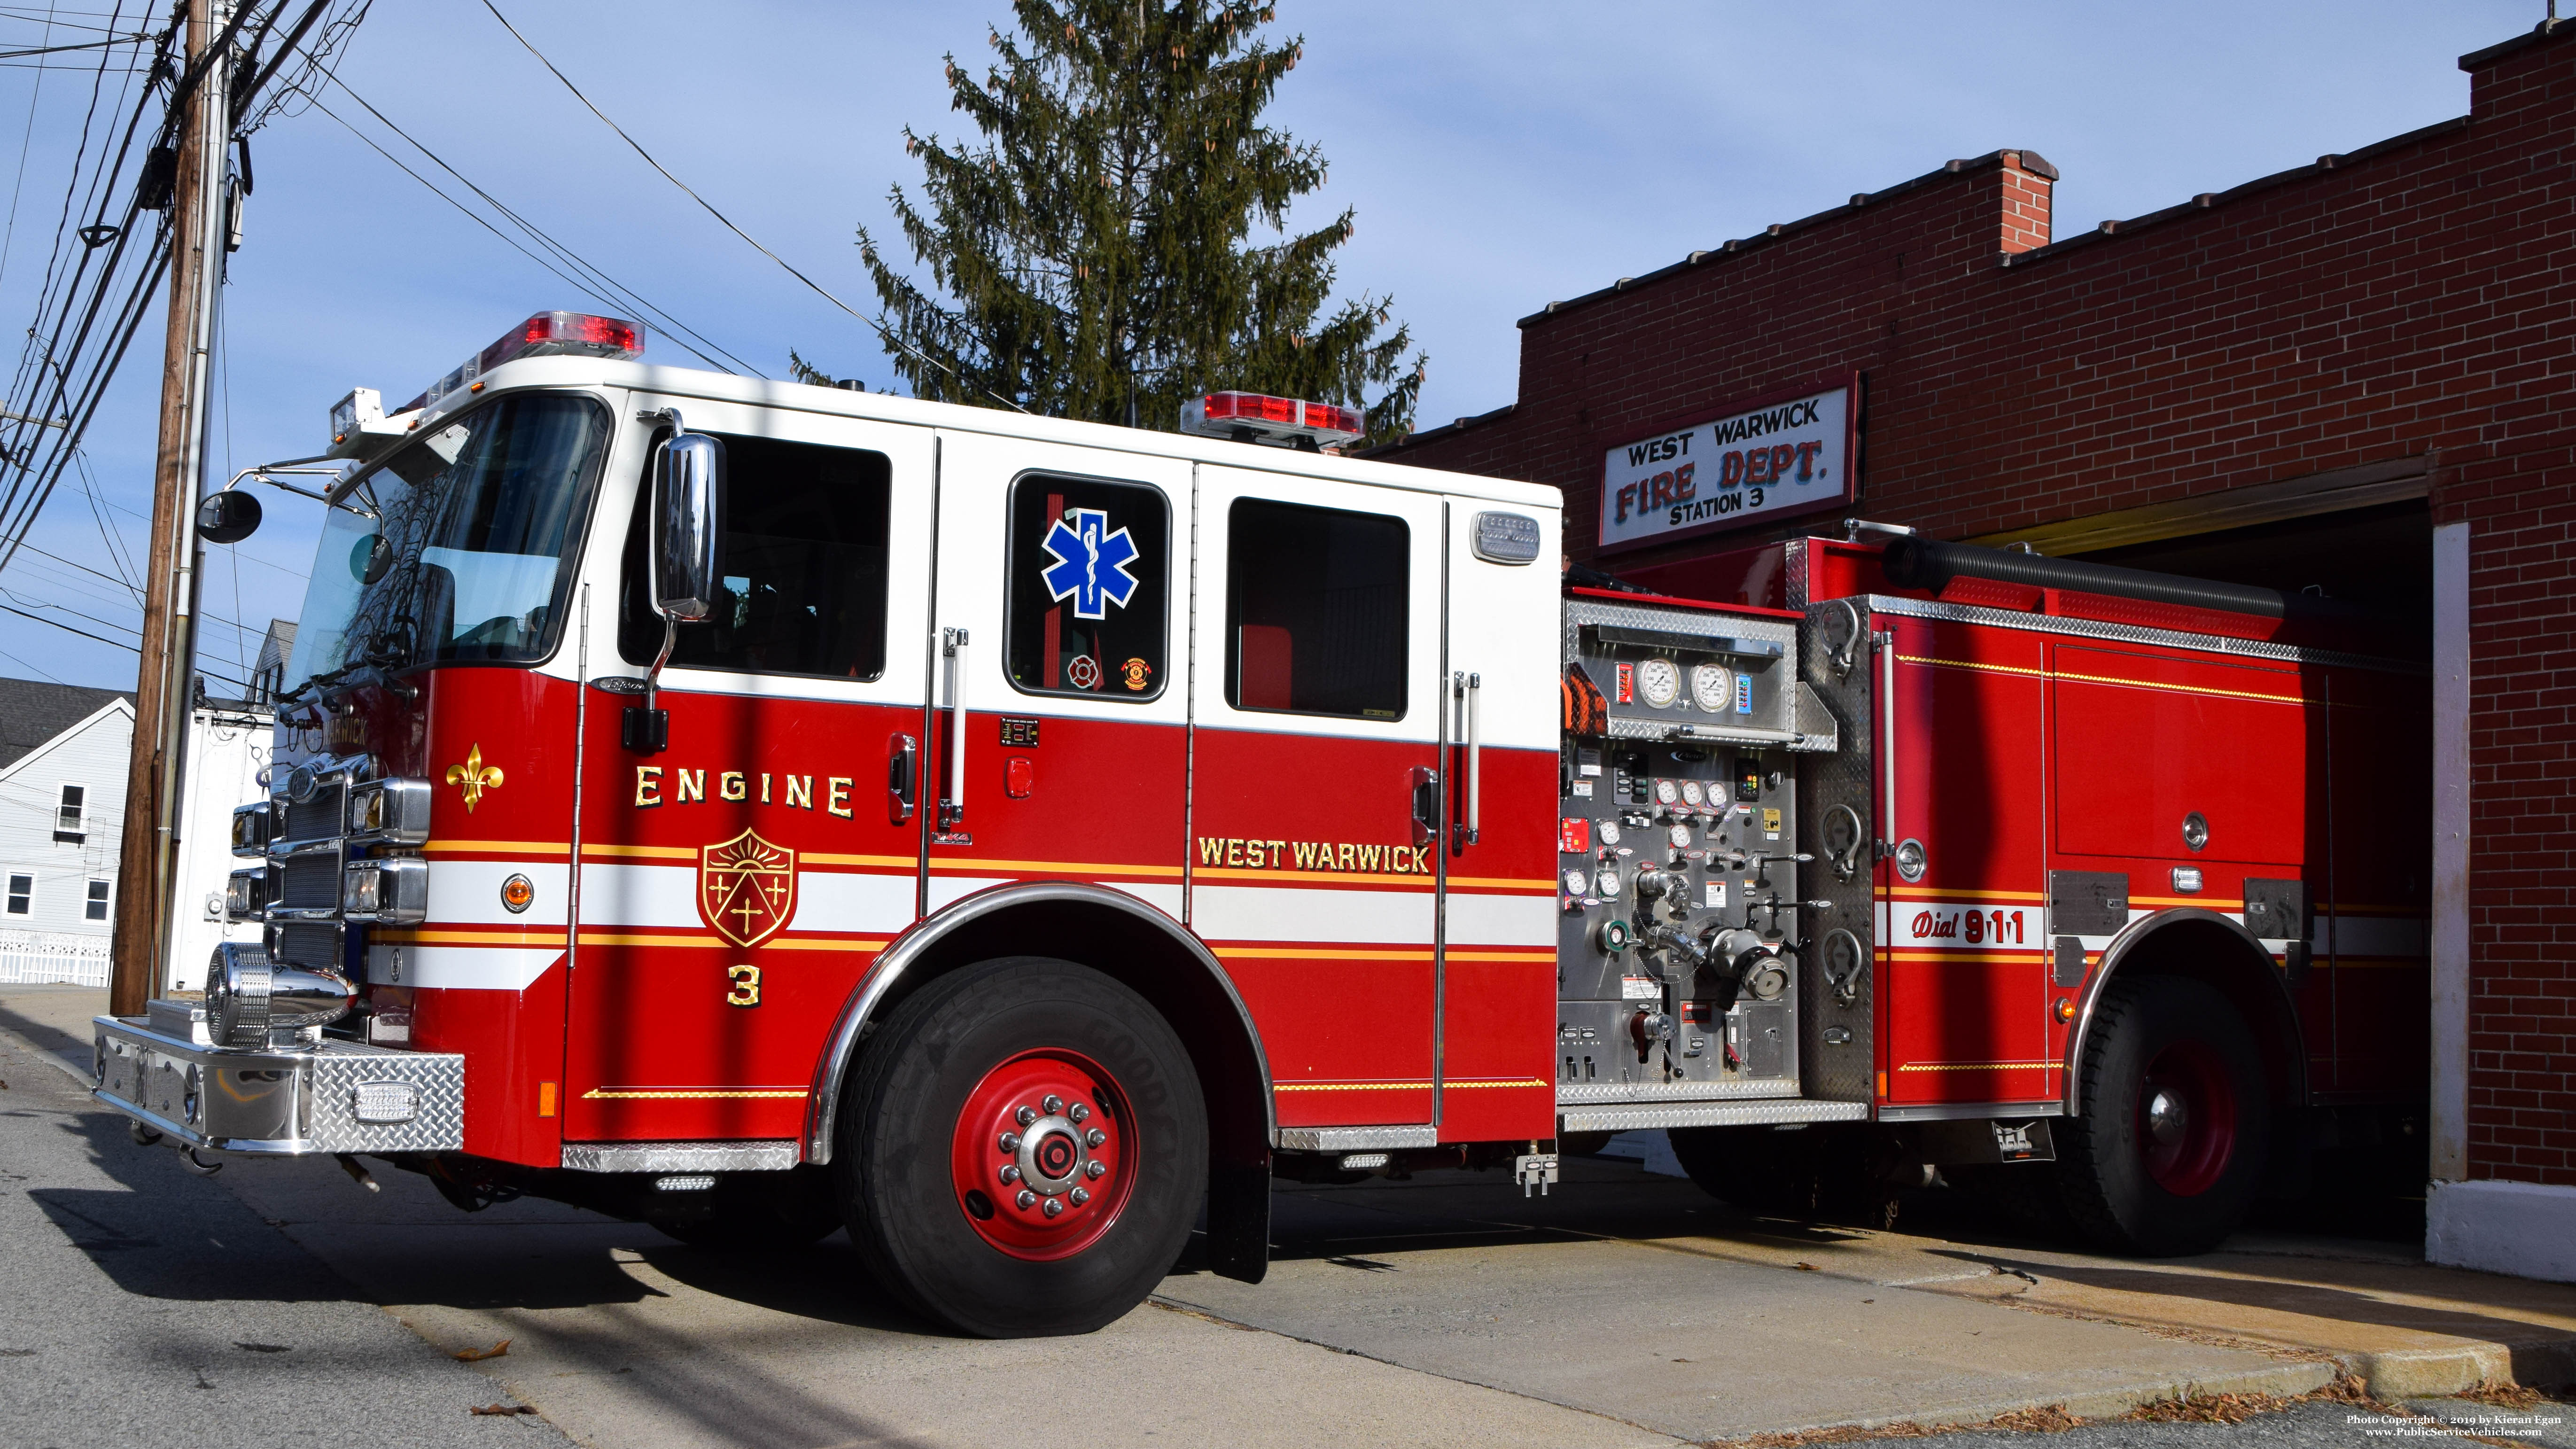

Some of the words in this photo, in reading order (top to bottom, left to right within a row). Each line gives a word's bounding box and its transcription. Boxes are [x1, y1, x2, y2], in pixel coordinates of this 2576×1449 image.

[1628, 432, 1694, 467] WEST
[1715, 399, 1819, 446] WARWICK
[1615, 461, 1697, 524] FIRE
[1718, 440, 1827, 489] DEPT.
[1669, 491, 1742, 525] STATION
[1749, 488, 1764, 507] 3
[635, 766, 855, 820] ENGINE
[1199, 837, 1288, 868] WEST
[1293, 841, 1431, 875] WARWICK
[1912, 910, 1959, 938] Dial
[727, 965, 763, 1007] 3
